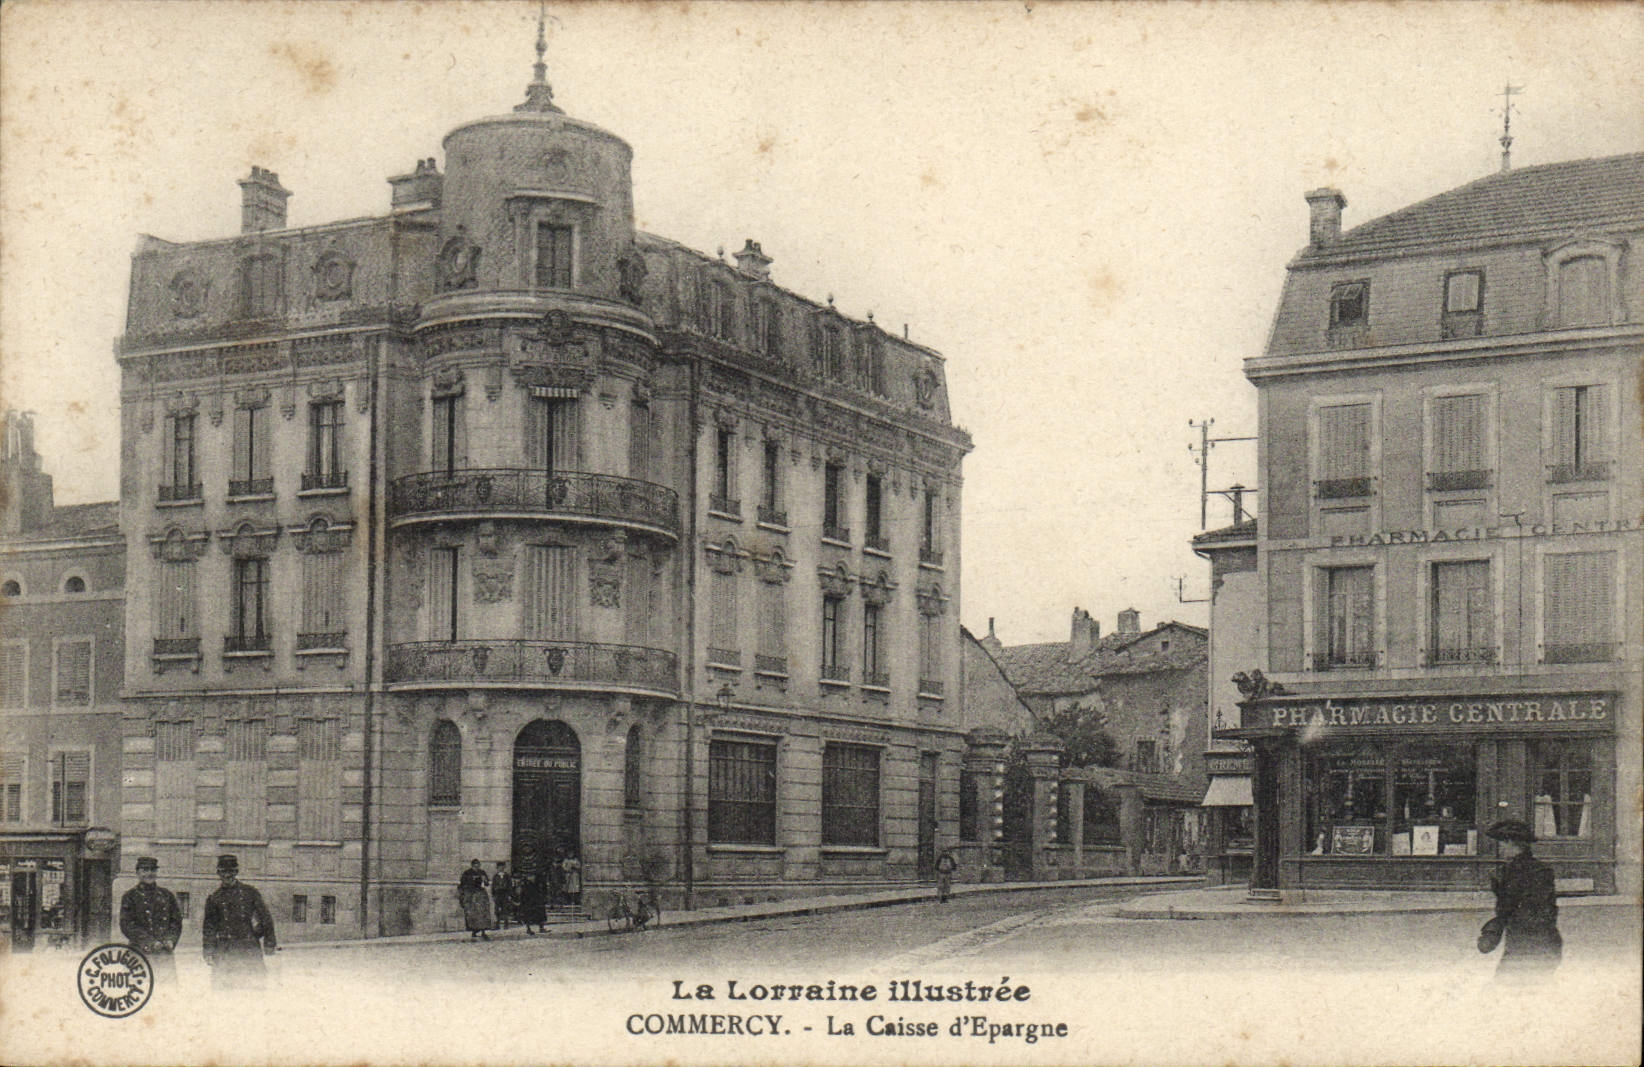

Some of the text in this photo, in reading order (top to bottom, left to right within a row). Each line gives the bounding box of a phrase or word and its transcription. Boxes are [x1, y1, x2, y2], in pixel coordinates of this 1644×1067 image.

[1331, 519, 1643, 547] PHARMACIE CENTR
[1272, 699, 1607, 727] PHARMACIE CENTRALE
